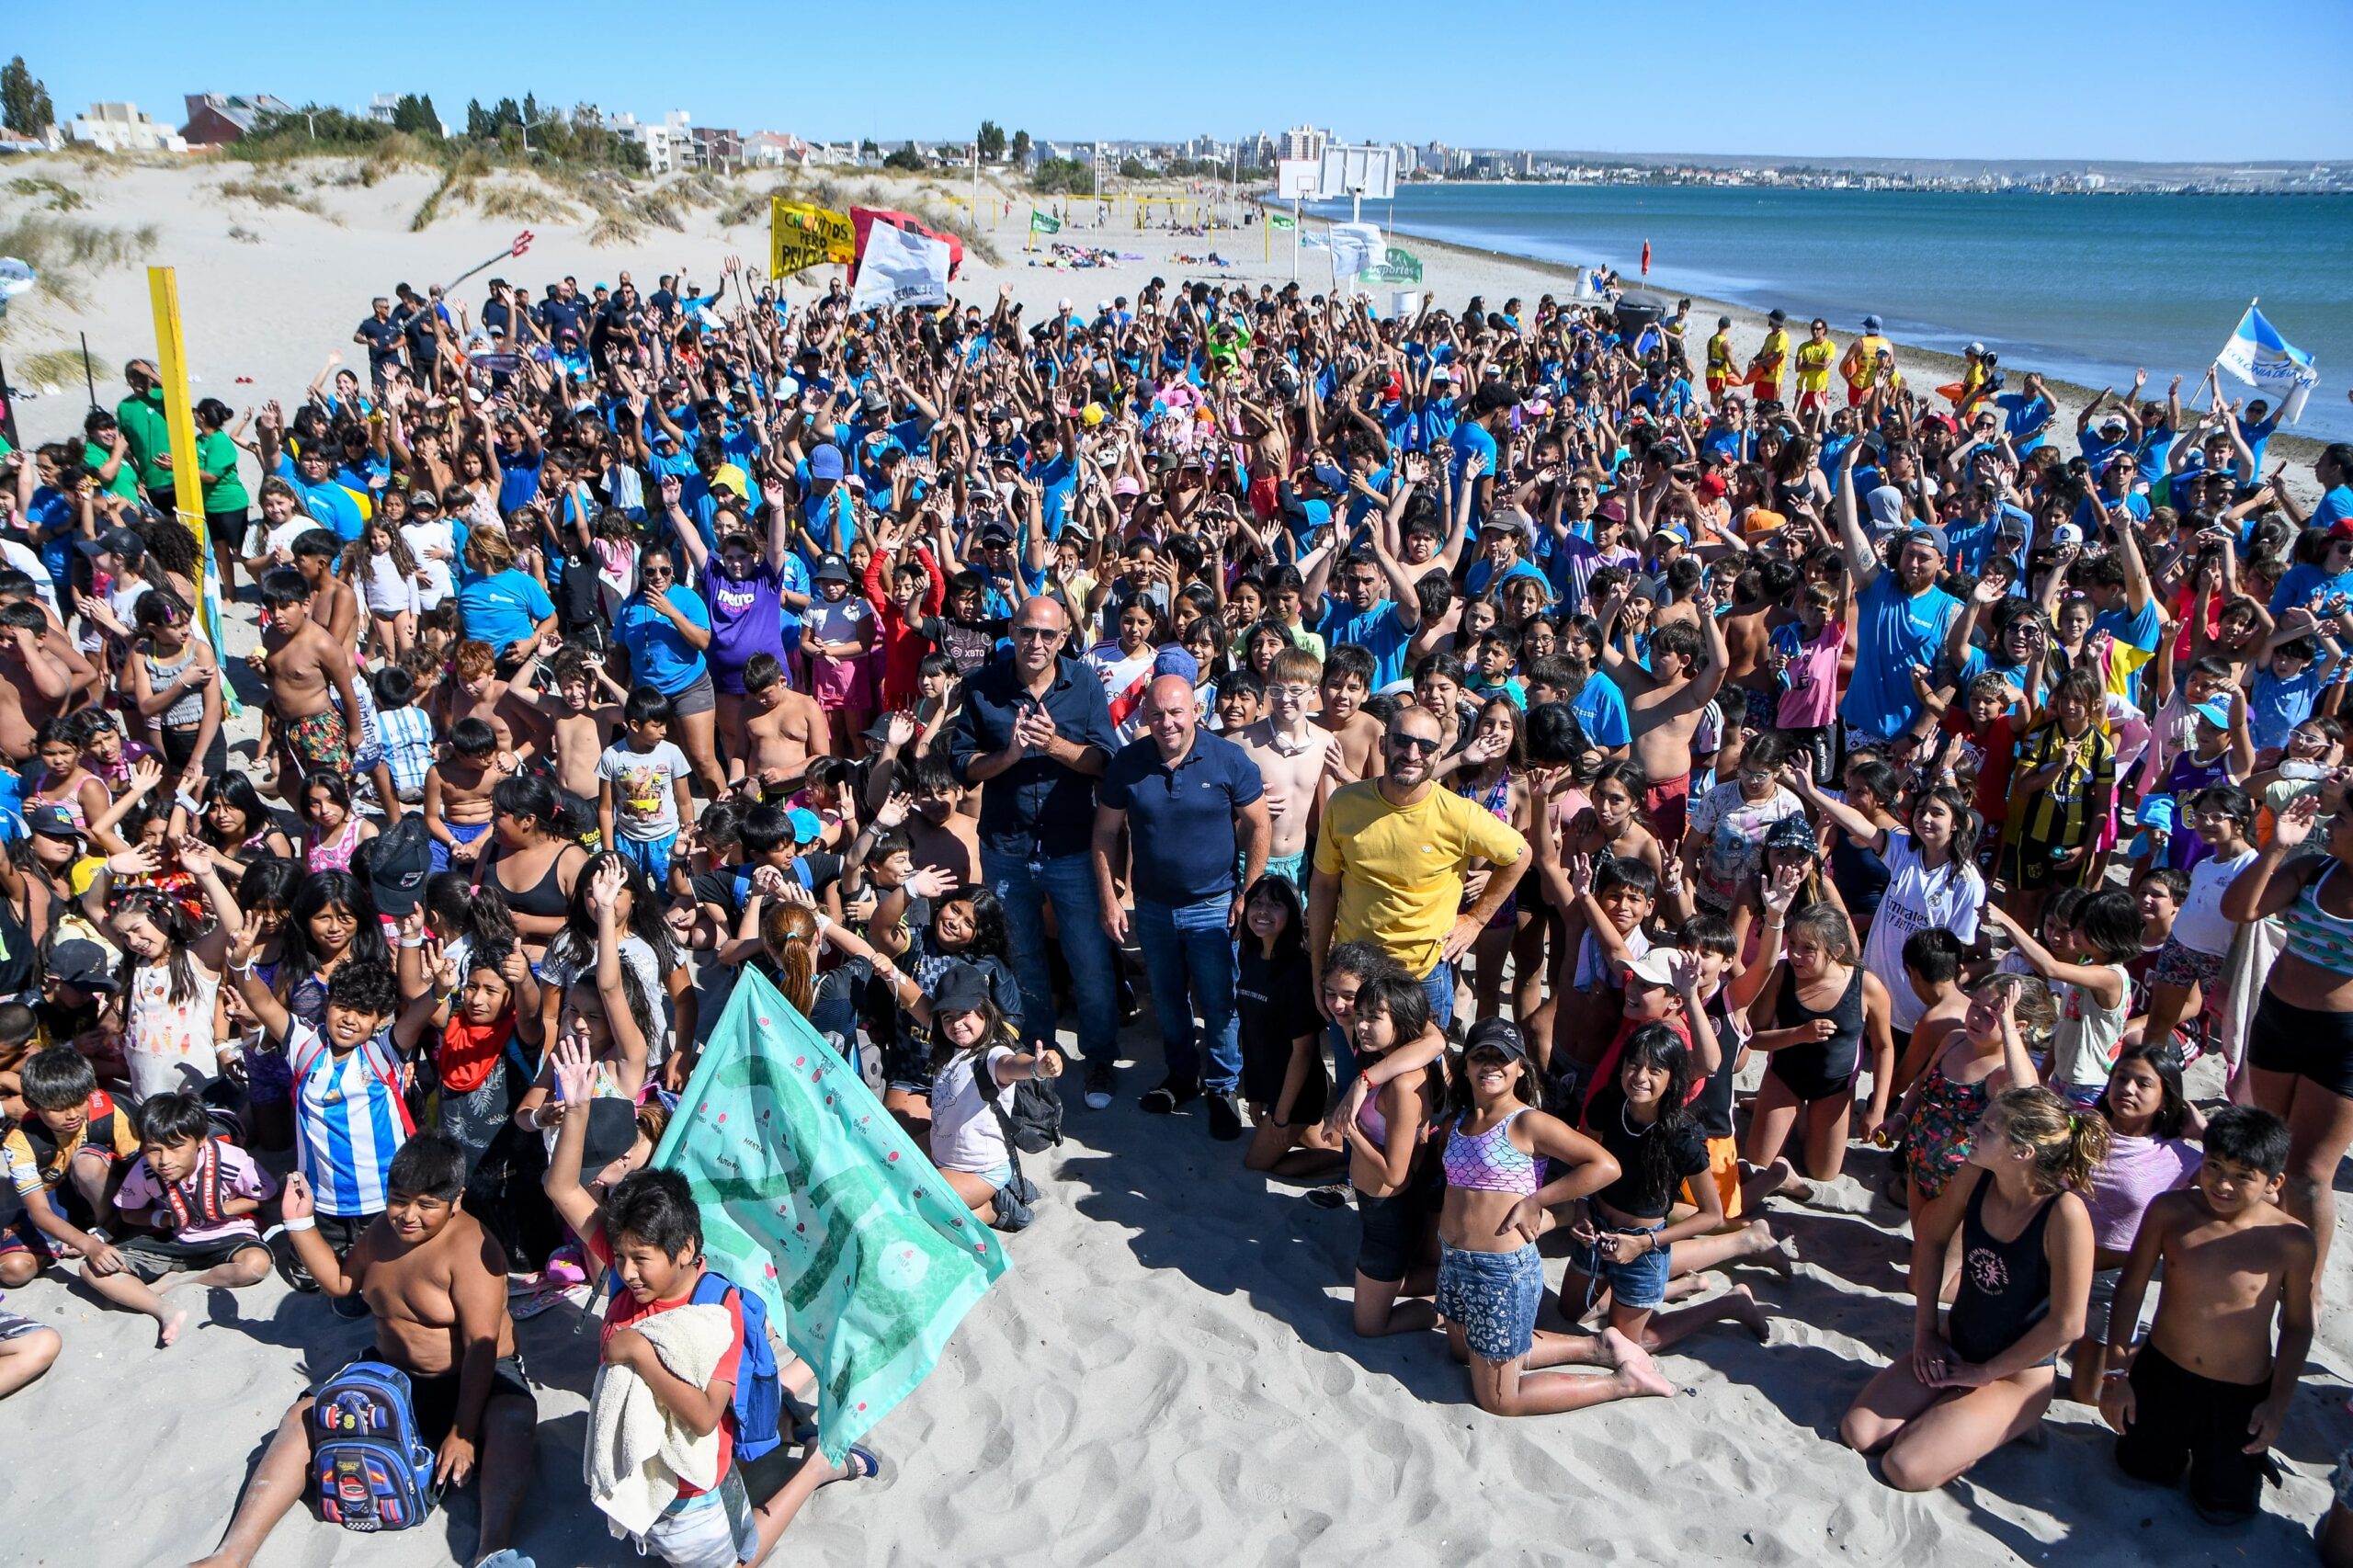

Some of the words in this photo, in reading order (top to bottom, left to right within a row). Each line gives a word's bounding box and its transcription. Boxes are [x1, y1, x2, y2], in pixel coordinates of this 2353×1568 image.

[800, 233, 827, 248] PERO
[2226, 347, 2271, 378] COLONIA
[964, 649, 984, 658] XBTO
[1889, 895, 1929, 926] mirates
